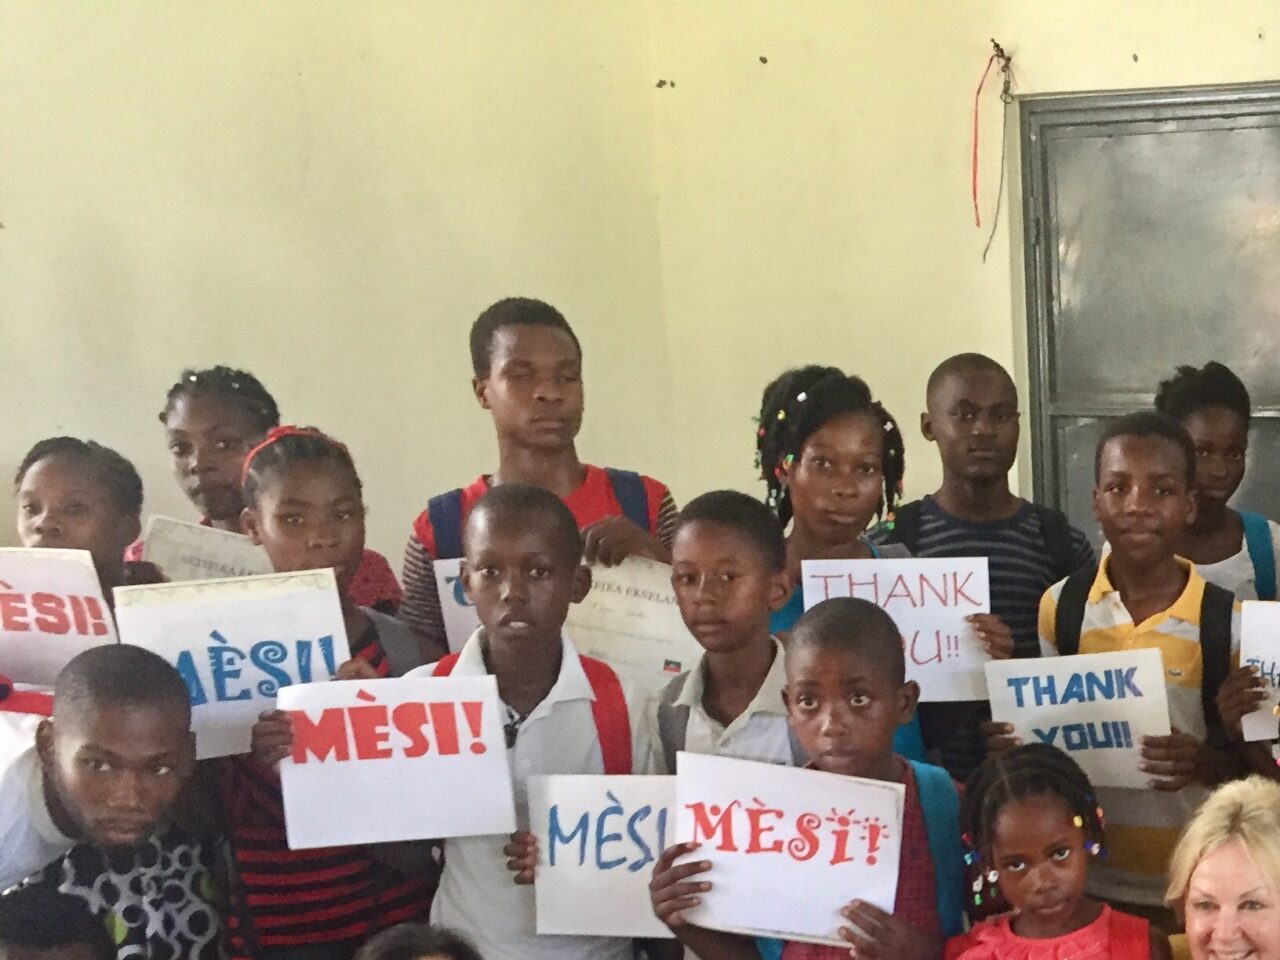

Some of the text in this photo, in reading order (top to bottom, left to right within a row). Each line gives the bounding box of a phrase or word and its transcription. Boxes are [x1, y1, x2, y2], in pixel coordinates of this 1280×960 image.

[0, 579, 108, 636] ÈSI!
[810, 571, 983, 608] THANK
[902, 630, 960, 665] U!!
[1007, 666, 1143, 708] THANK
[288, 689, 487, 764] MÈSI!
